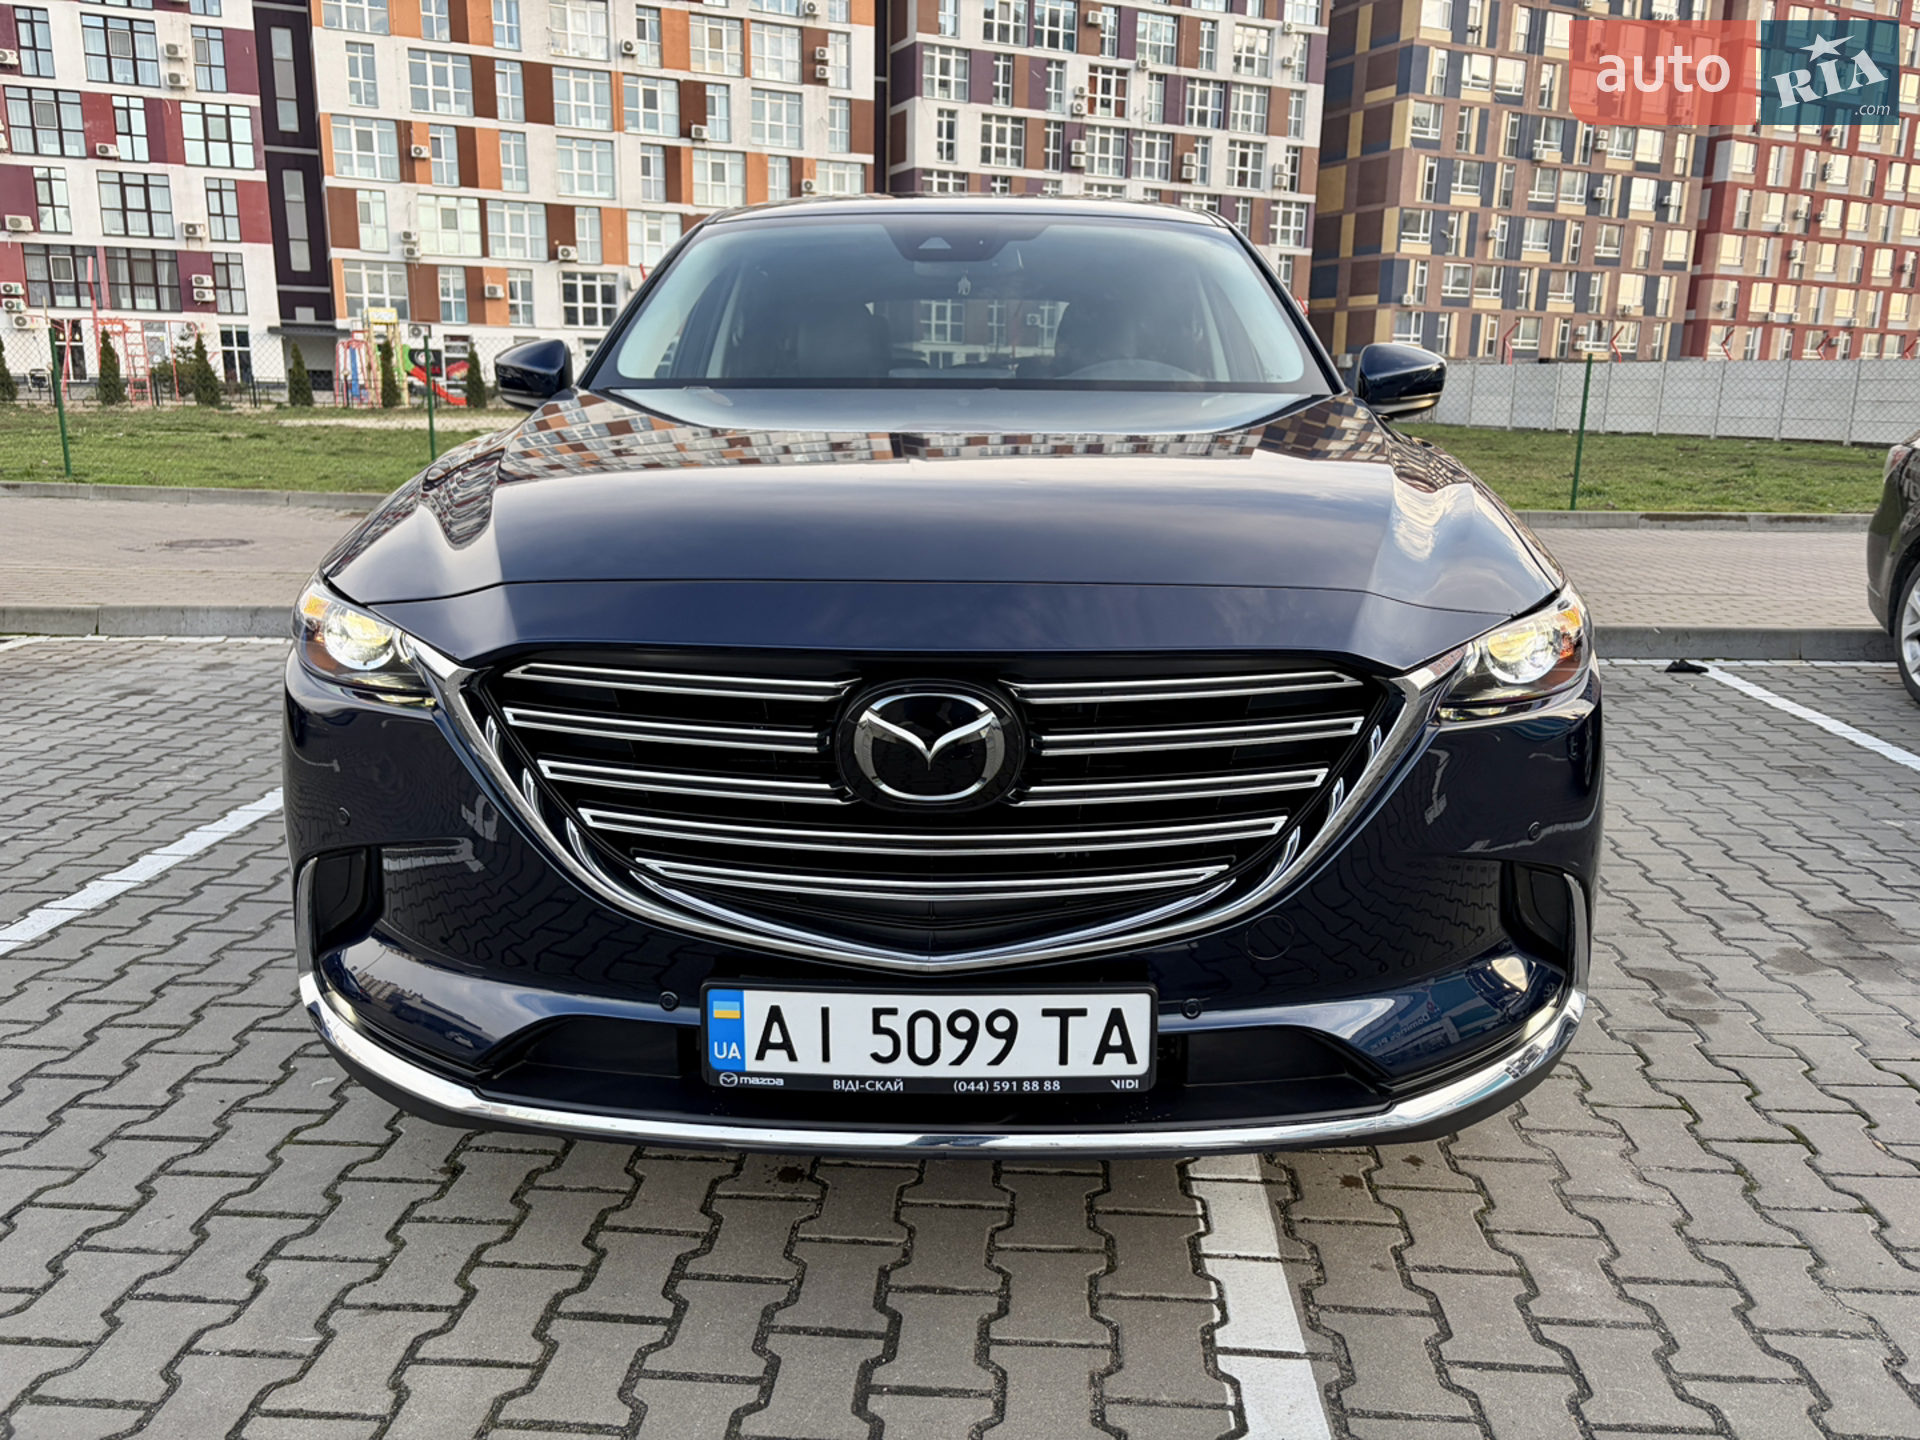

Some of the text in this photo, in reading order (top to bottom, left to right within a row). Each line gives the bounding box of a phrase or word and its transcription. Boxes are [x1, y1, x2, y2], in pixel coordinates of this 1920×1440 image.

[755, 1004, 1138, 1066] AI 5099 TA
[714, 1041, 742, 1060] UA
[832, 1078, 904, 1092] ВІДІ-СКАЙ
[953, 1079, 1061, 1093] (044) 591 88 88
[1110, 1079, 1139, 1090] VIDI
